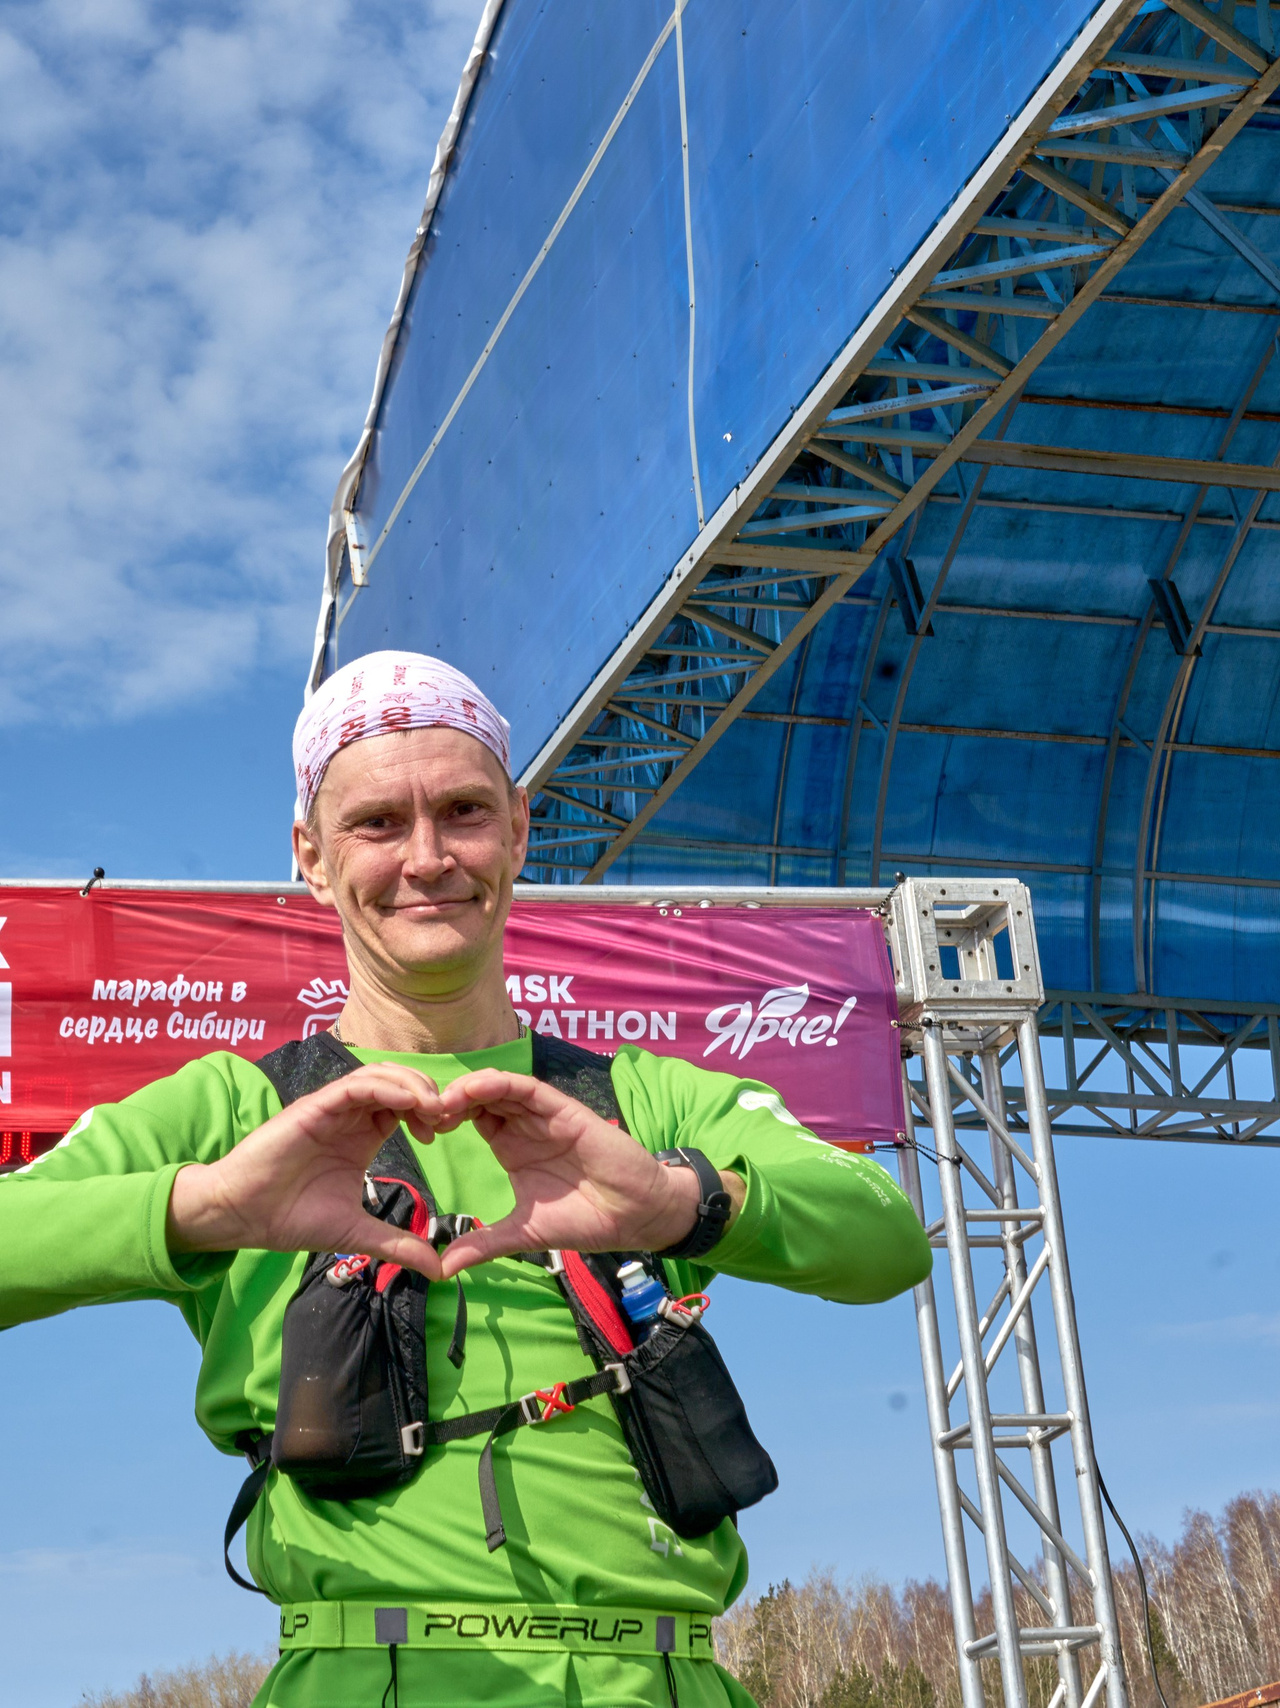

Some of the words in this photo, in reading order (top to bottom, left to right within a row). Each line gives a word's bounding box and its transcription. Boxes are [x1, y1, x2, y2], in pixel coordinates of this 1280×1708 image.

[91, 974, 224, 1007] марафон
[230, 979, 247, 1002] в
[59, 1015, 159, 1045] сердце
[166, 1011, 266, 1046] Сибири
[703, 996, 858, 1061] Ярче!
[424, 1613, 644, 1643] POWERUP
